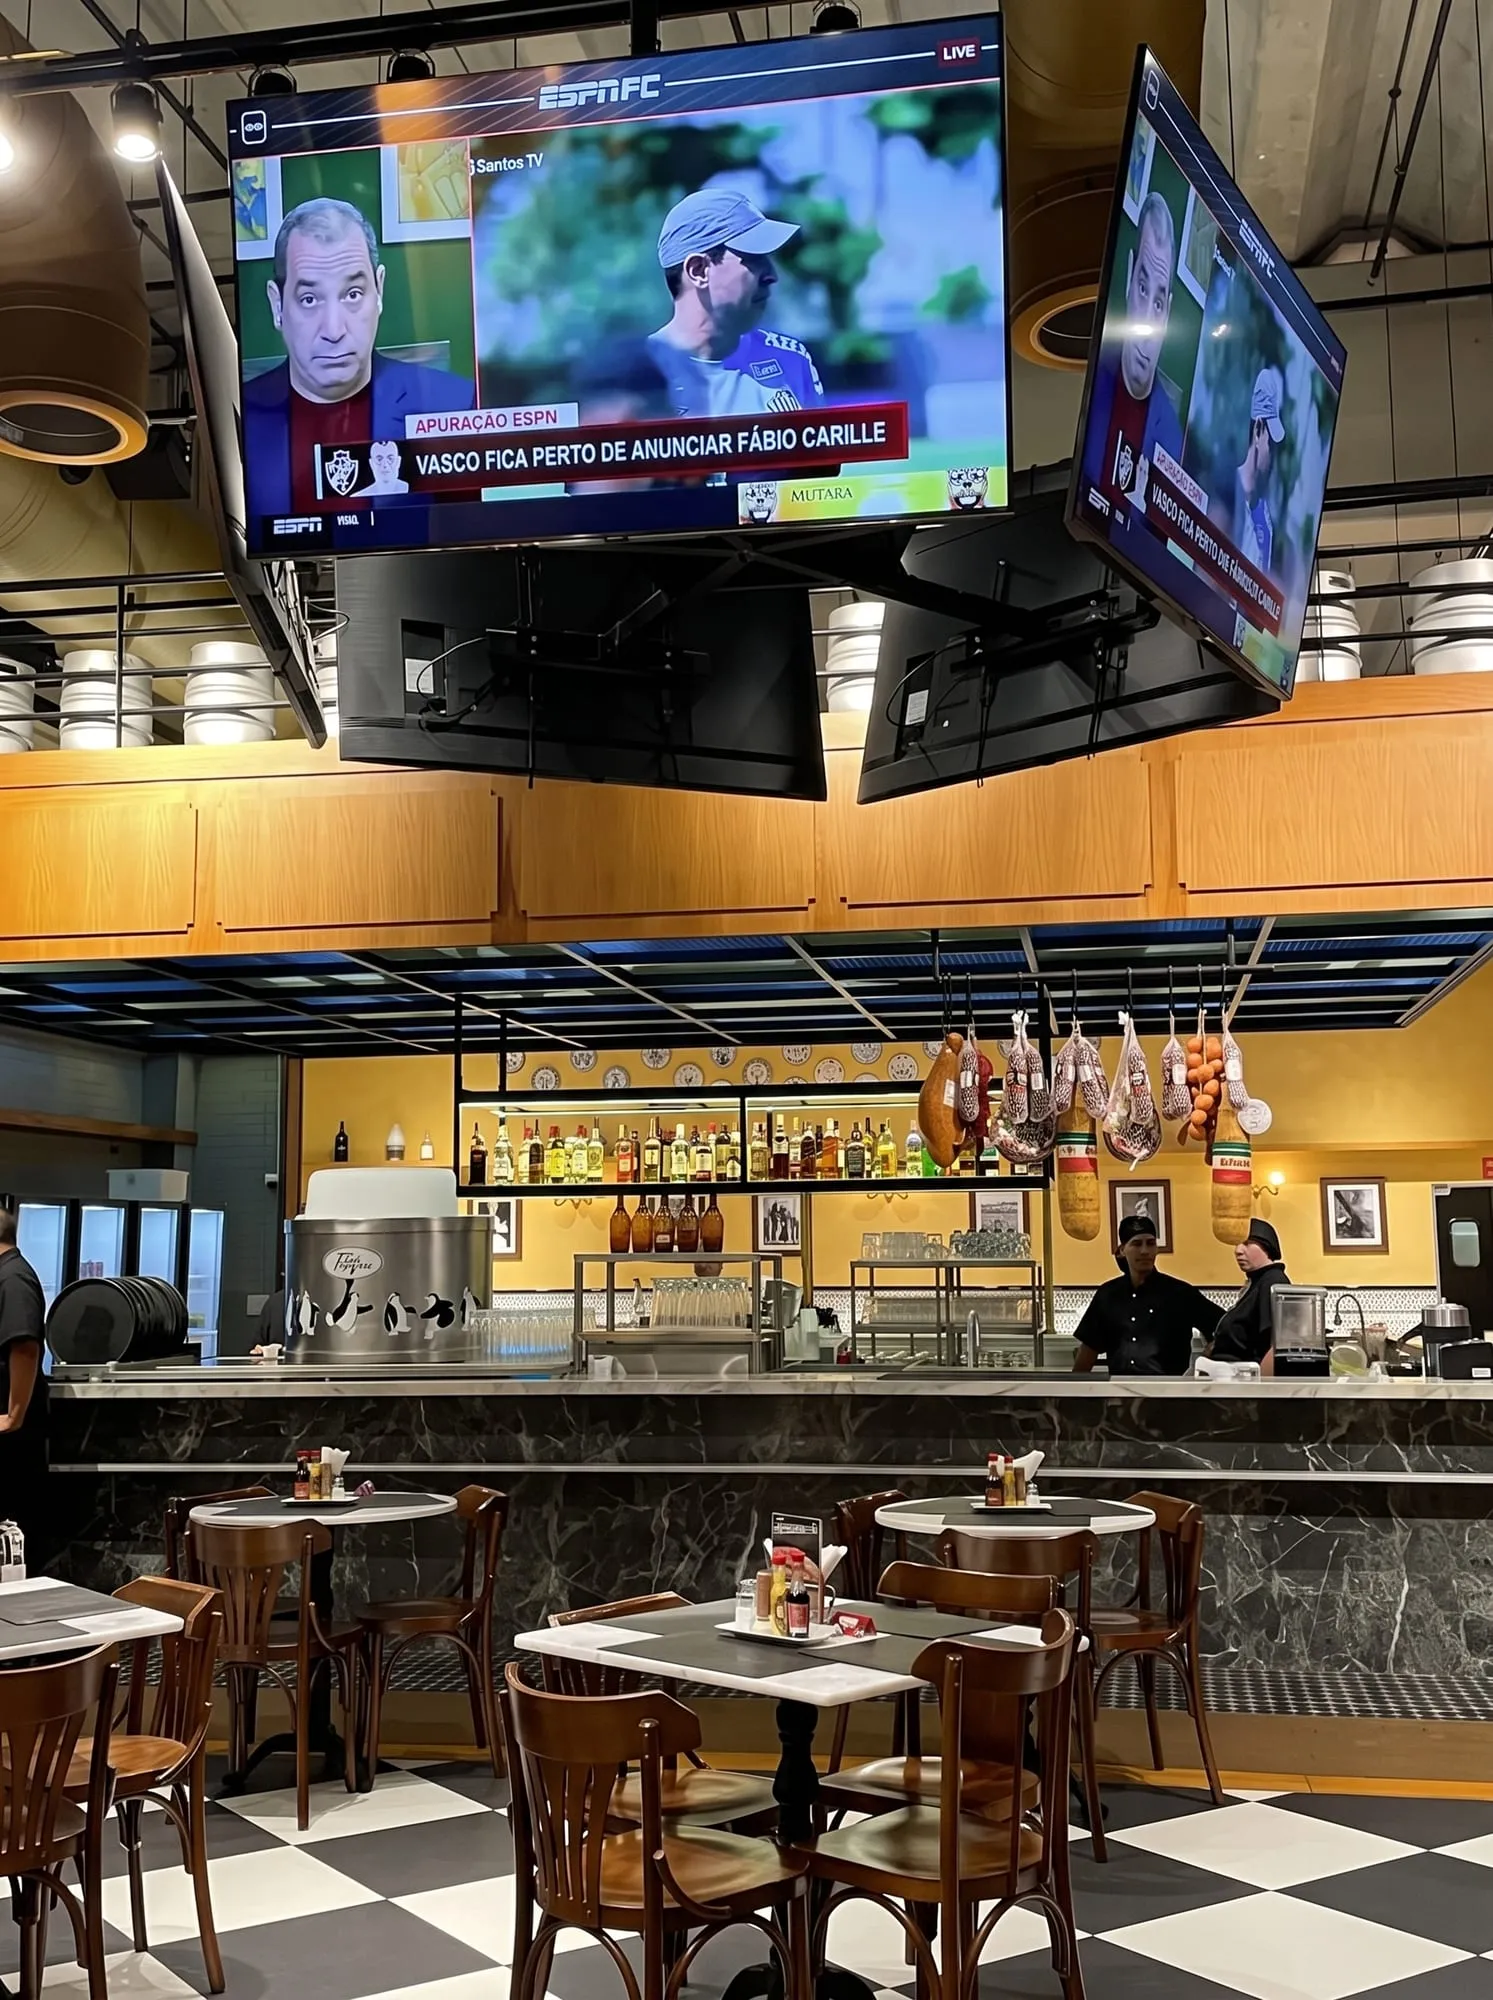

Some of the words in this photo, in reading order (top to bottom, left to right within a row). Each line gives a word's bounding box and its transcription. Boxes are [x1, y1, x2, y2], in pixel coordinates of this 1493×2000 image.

[942, 44, 976, 61] LIVE
[477, 157, 525, 174] Santos
[526, 153, 544, 169] TV
[415, 411, 508, 435] APURAÇÃO
[513, 408, 558, 430] ESPN
[416, 451, 480, 476] VASCO
[484, 447, 529, 473] FICA
[532, 443, 596, 468] PERTO
[601, 439, 626, 464] DE
[631, 432, 732, 462] ANUNCIAR
[737, 425, 797, 454] FÁBIO
[801, 421, 886, 447] CARILLE
[790, 486, 853, 502] MUTARA
[273, 516, 323, 535] ESPN
[1152, 483, 1178, 522] VASCO
[1177, 509, 1195, 538] FICA
[1194, 525, 1219, 560] PERTO
